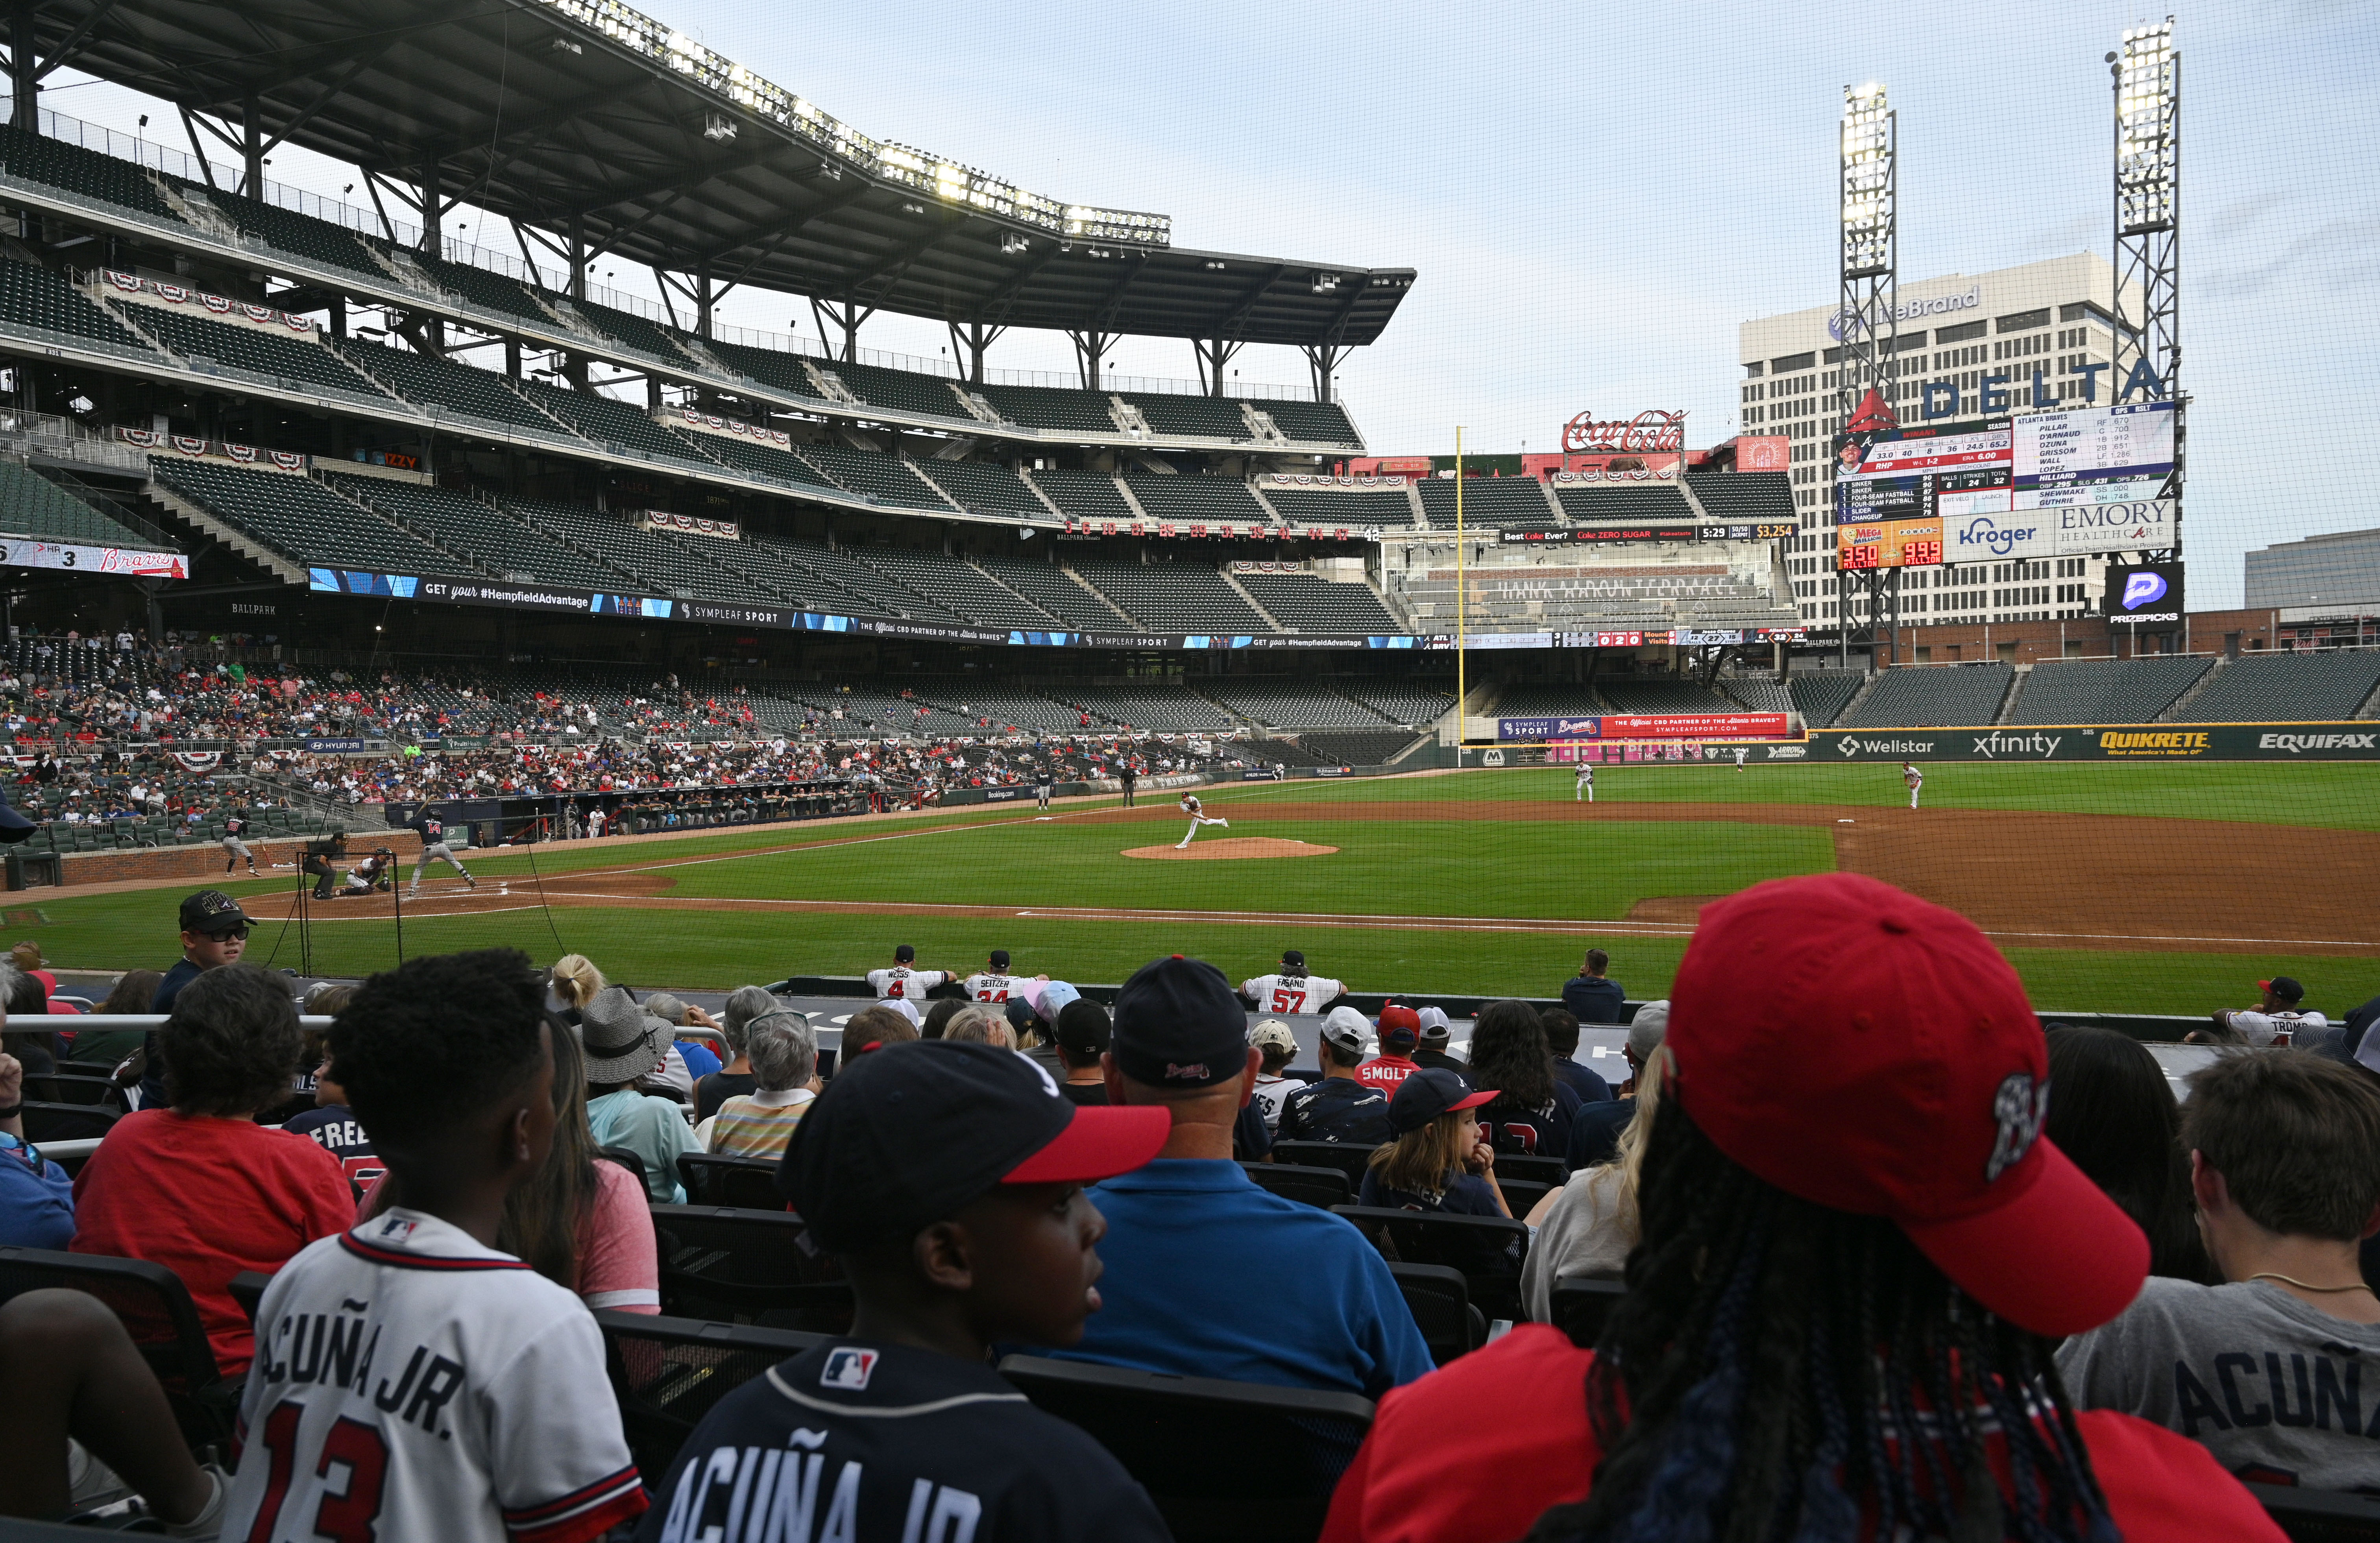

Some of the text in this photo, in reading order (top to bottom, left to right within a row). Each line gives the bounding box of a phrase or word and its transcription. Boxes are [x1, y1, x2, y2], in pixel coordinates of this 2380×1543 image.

[1923, 358, 2166, 421] DELTA
[1903, 429, 1936, 438] WINANS
[2040, 431, 2080, 440] D'ARNAUD
[2040, 448, 2076, 456] GRISSOM
[2039, 473, 2076, 481] HILLIARD
[2040, 488, 2085, 497] SHEWMAKE
[2060, 501, 2169, 529] EMORY
[1065, 521, 1207, 538] 3 6 10 21 25 29
[1221, 526, 1378, 541] 31 35 41 44 47 42
[1577, 531, 1596, 539] Coke
[1703, 528, 1724, 537] 5:29
[1757, 525, 1792, 538] $3,254
[1856, 529, 1881, 538] MEGA
[1960, 518, 2036, 554] Kroger
[2062, 526, 2163, 541] HEALTHCARE
[1853, 535, 1882, 544] MILLIONS
[63, 551, 75, 567] 3
[100, 548, 170, 572] Braves
[1843, 560, 1877, 568] MILLION
[1906, 556, 1940, 564] MILLION
[425, 583, 588, 608] GET your #HempfieldAdvantage
[1498, 581, 1553, 599] HANK
[1560, 579, 1631, 597] AARON
[233, 604, 275, 615] BALLPARK
[695, 608, 777, 623] SYMPLEAF SPORT
[2111, 613, 2178, 623] PRIZEPICKS
[875, 622, 895, 634] Official
[911, 627, 936, 636] PARTNER
[960, 630, 977, 638] Atlanta
[1558, 720, 1591, 732] Braves
[1864, 740, 1934, 752] Wellstar
[1973, 731, 2061, 758] xfinity
[2099, 732, 2208, 748] QUIKRETE
[2260, 734, 2375, 752] EQUIFAX
[1166, 775, 1200, 786] MLB NETWORK
[428, 823, 440, 833] 14
[888, 981, 904, 998] 4
[1278, 979, 1304, 988] FASANO
[1272, 989, 1305, 1013] 57
[375, 1346, 465, 1440] JR.
[247, 1400, 390, 1543] 13
[659, 1428, 863, 1543] ACUÑA
